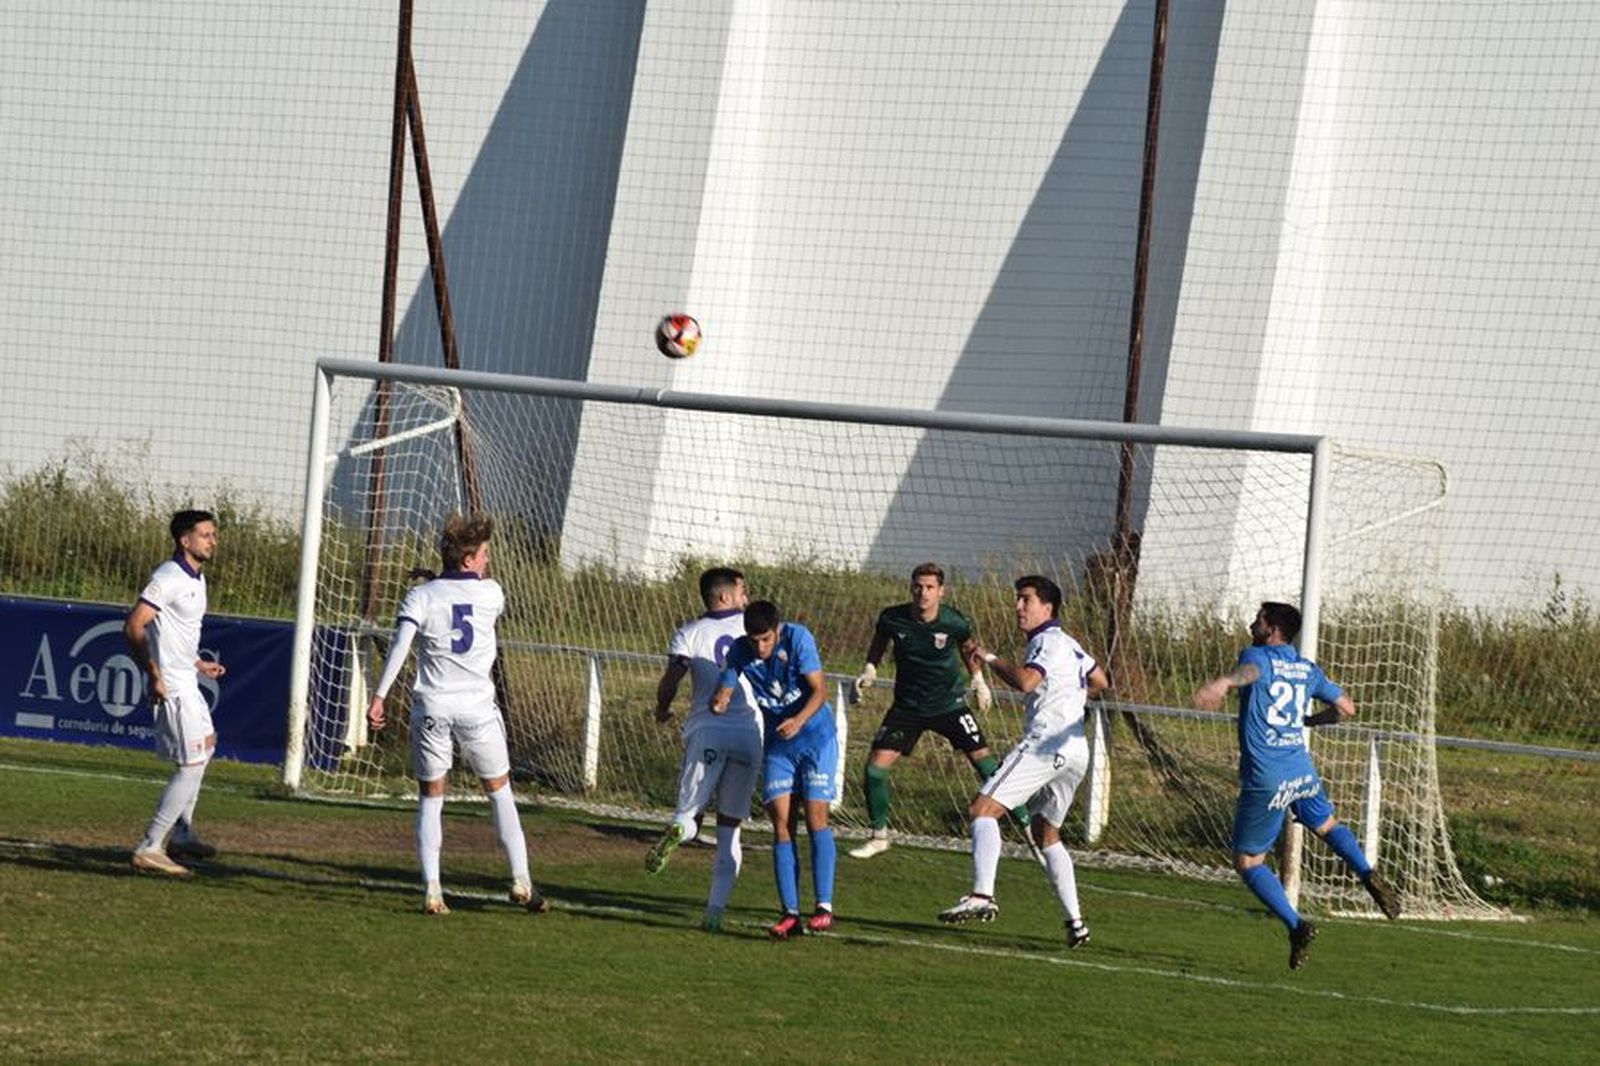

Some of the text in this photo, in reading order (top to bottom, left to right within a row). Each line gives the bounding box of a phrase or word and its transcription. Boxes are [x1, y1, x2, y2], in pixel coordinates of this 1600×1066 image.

[450, 603, 475, 655] 5
[1266, 681, 1306, 729] 21
[110, 720, 125, 735] de
[959, 714, 978, 734] 13
